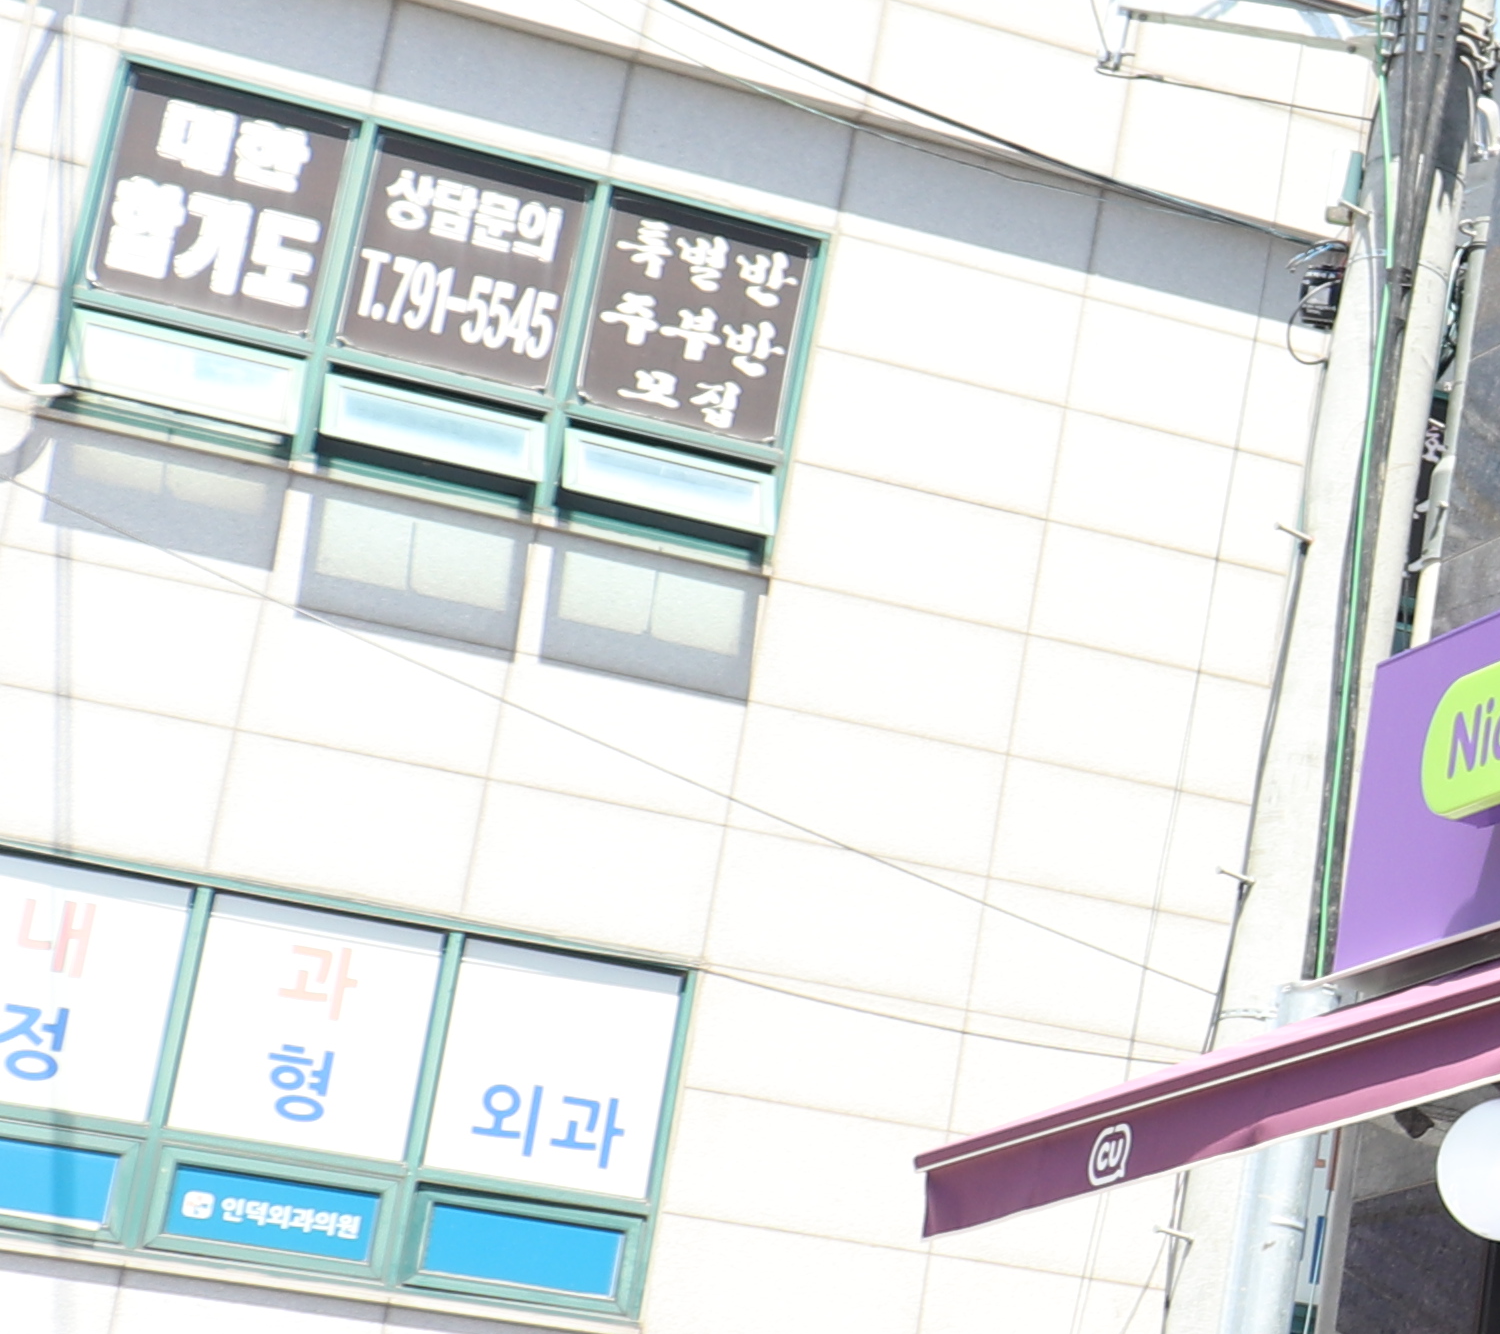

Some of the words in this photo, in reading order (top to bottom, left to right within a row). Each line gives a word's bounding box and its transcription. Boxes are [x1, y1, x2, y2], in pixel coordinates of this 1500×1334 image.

[155, 98, 312, 194] 대한
[103, 174, 323, 311] 합기도
[384, 168, 566, 264] 상담문의
[356, 247, 561, 362] T.791-5545
[616, 217, 797, 309] 특별반
[600, 291, 787, 380] 주부반
[618, 367, 743, 431] 모집
[1095, 1137, 1124, 1171] CU
[219, 1195, 363, 1241] 인덕외과의원
